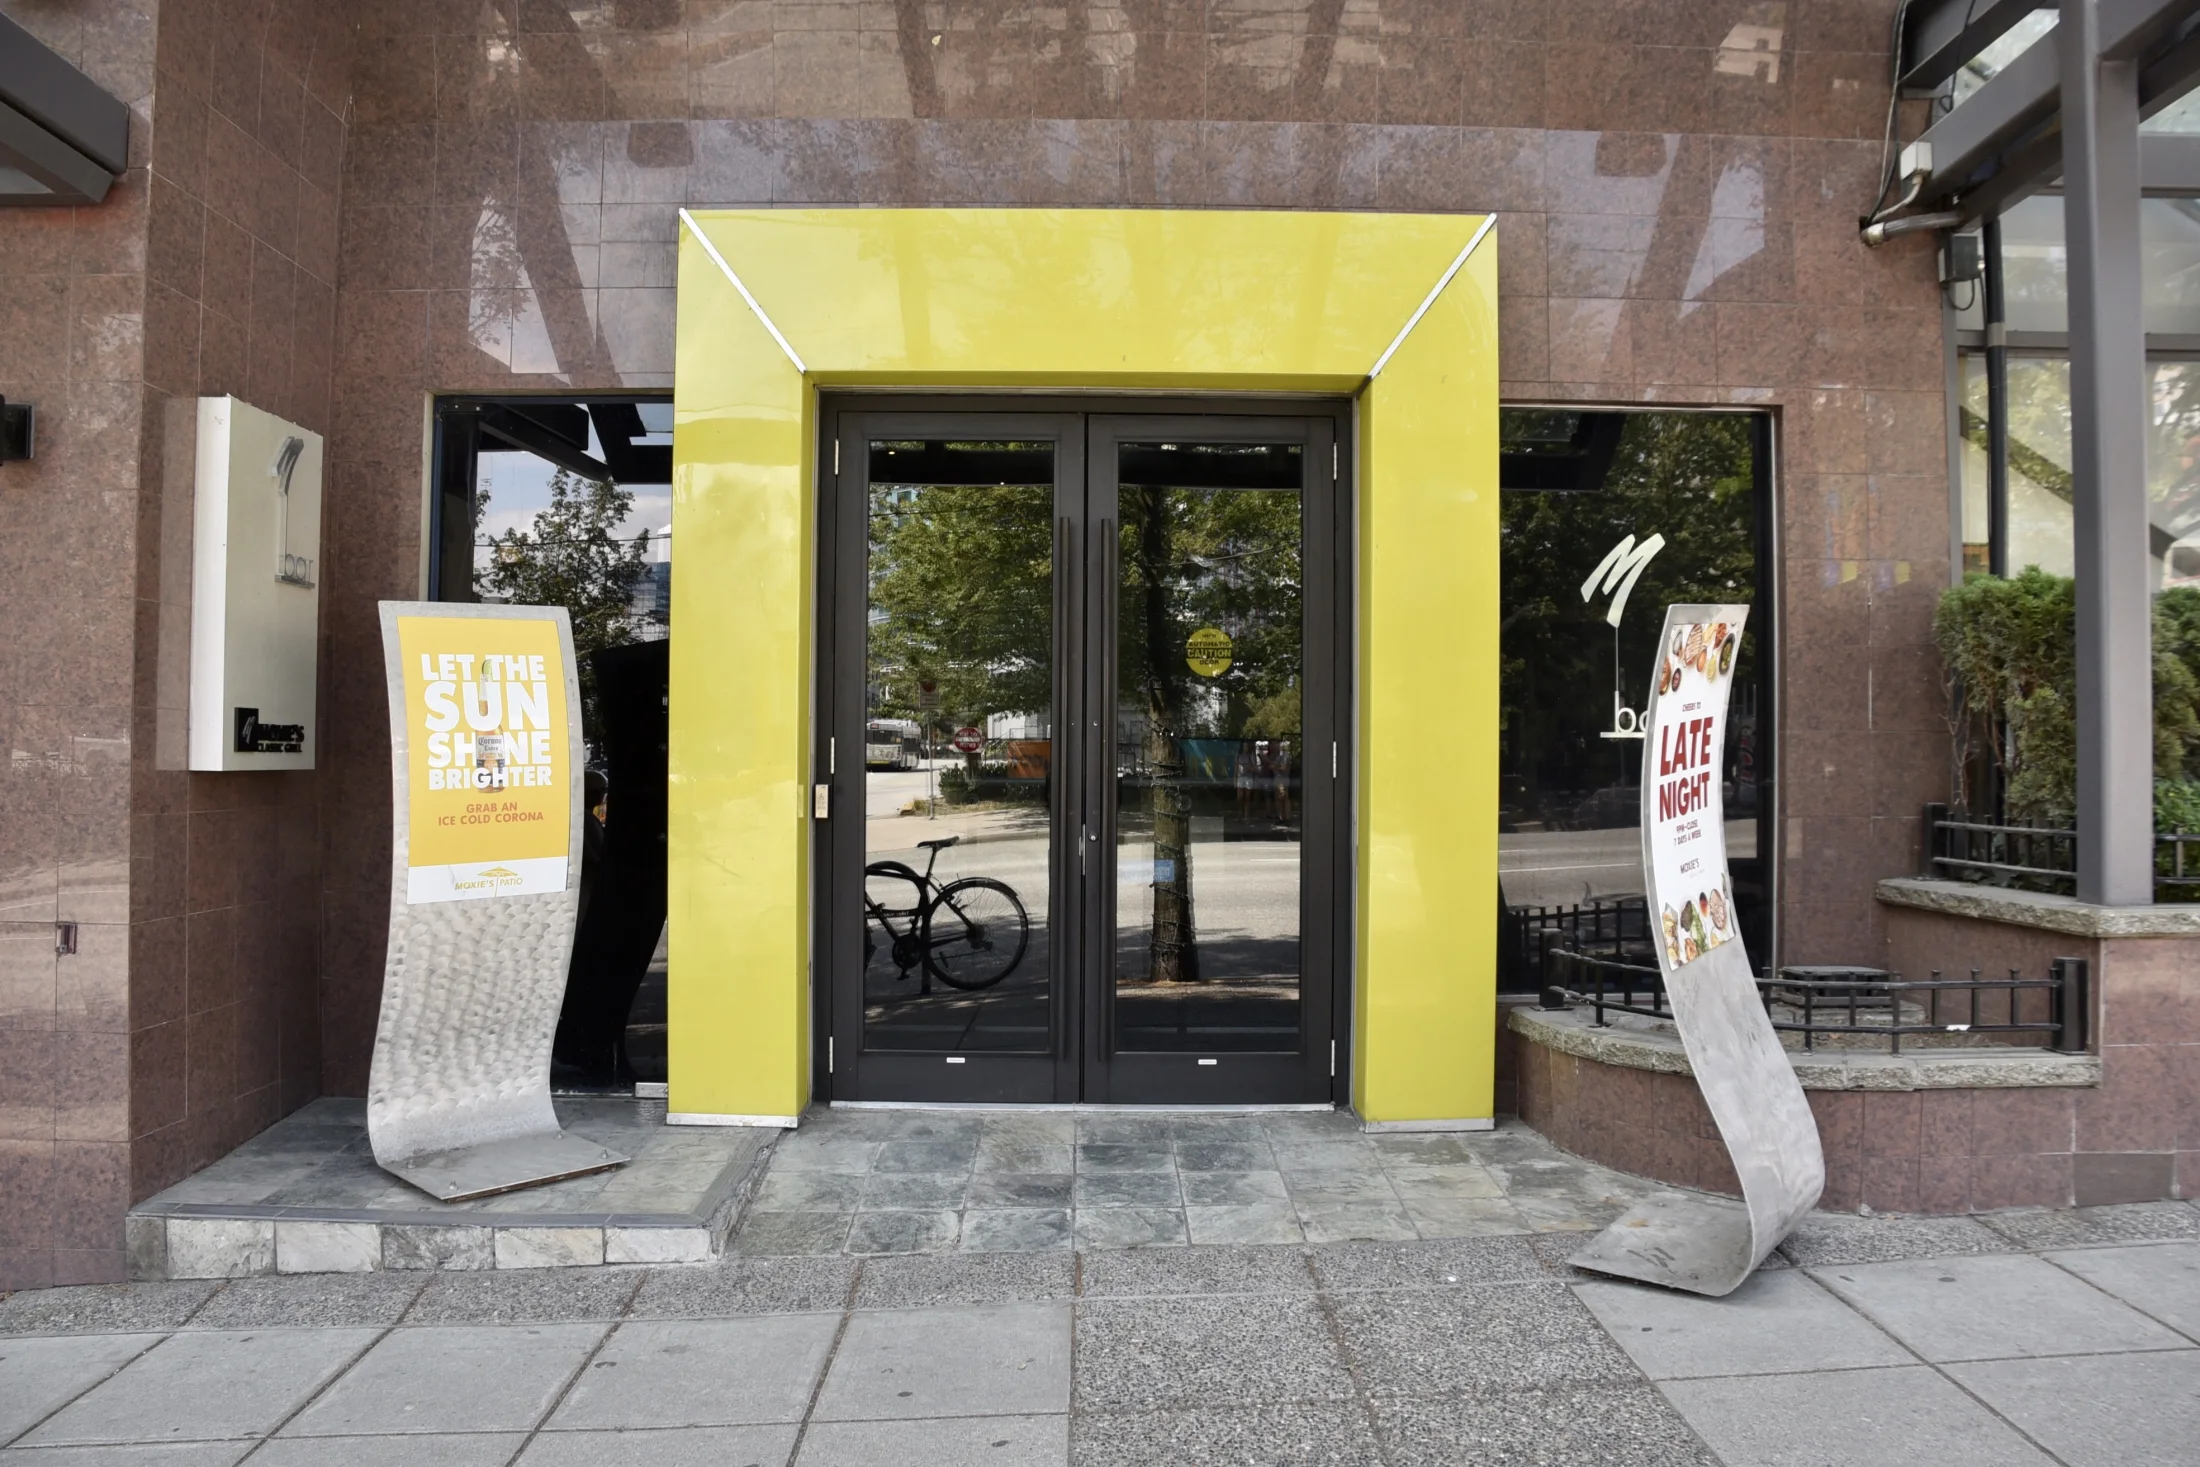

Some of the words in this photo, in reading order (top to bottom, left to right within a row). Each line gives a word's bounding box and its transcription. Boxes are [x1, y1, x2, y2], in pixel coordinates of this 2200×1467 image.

[1187, 649, 1231, 658] CAUTION
[421, 653, 475, 681] LET
[485, 654, 547, 681] THE
[424, 680, 550, 733] SUN
[427, 731, 552, 768] SHNE
[478, 736, 502, 746] Corona
[1660, 716, 1714, 777] LATE
[428, 766, 552, 791] BRIGHTER
[466, 803, 498, 814] GRAB
[501, 802, 518, 812] AN
[1659, 771, 1711, 823] NIGHT
[438, 815, 456, 827] ICE
[460, 814, 491, 825] COLD
[494, 811, 544, 824] CORONA
[454, 880, 495, 891] MOXIE'S
[499, 877, 524, 887] PATIO
